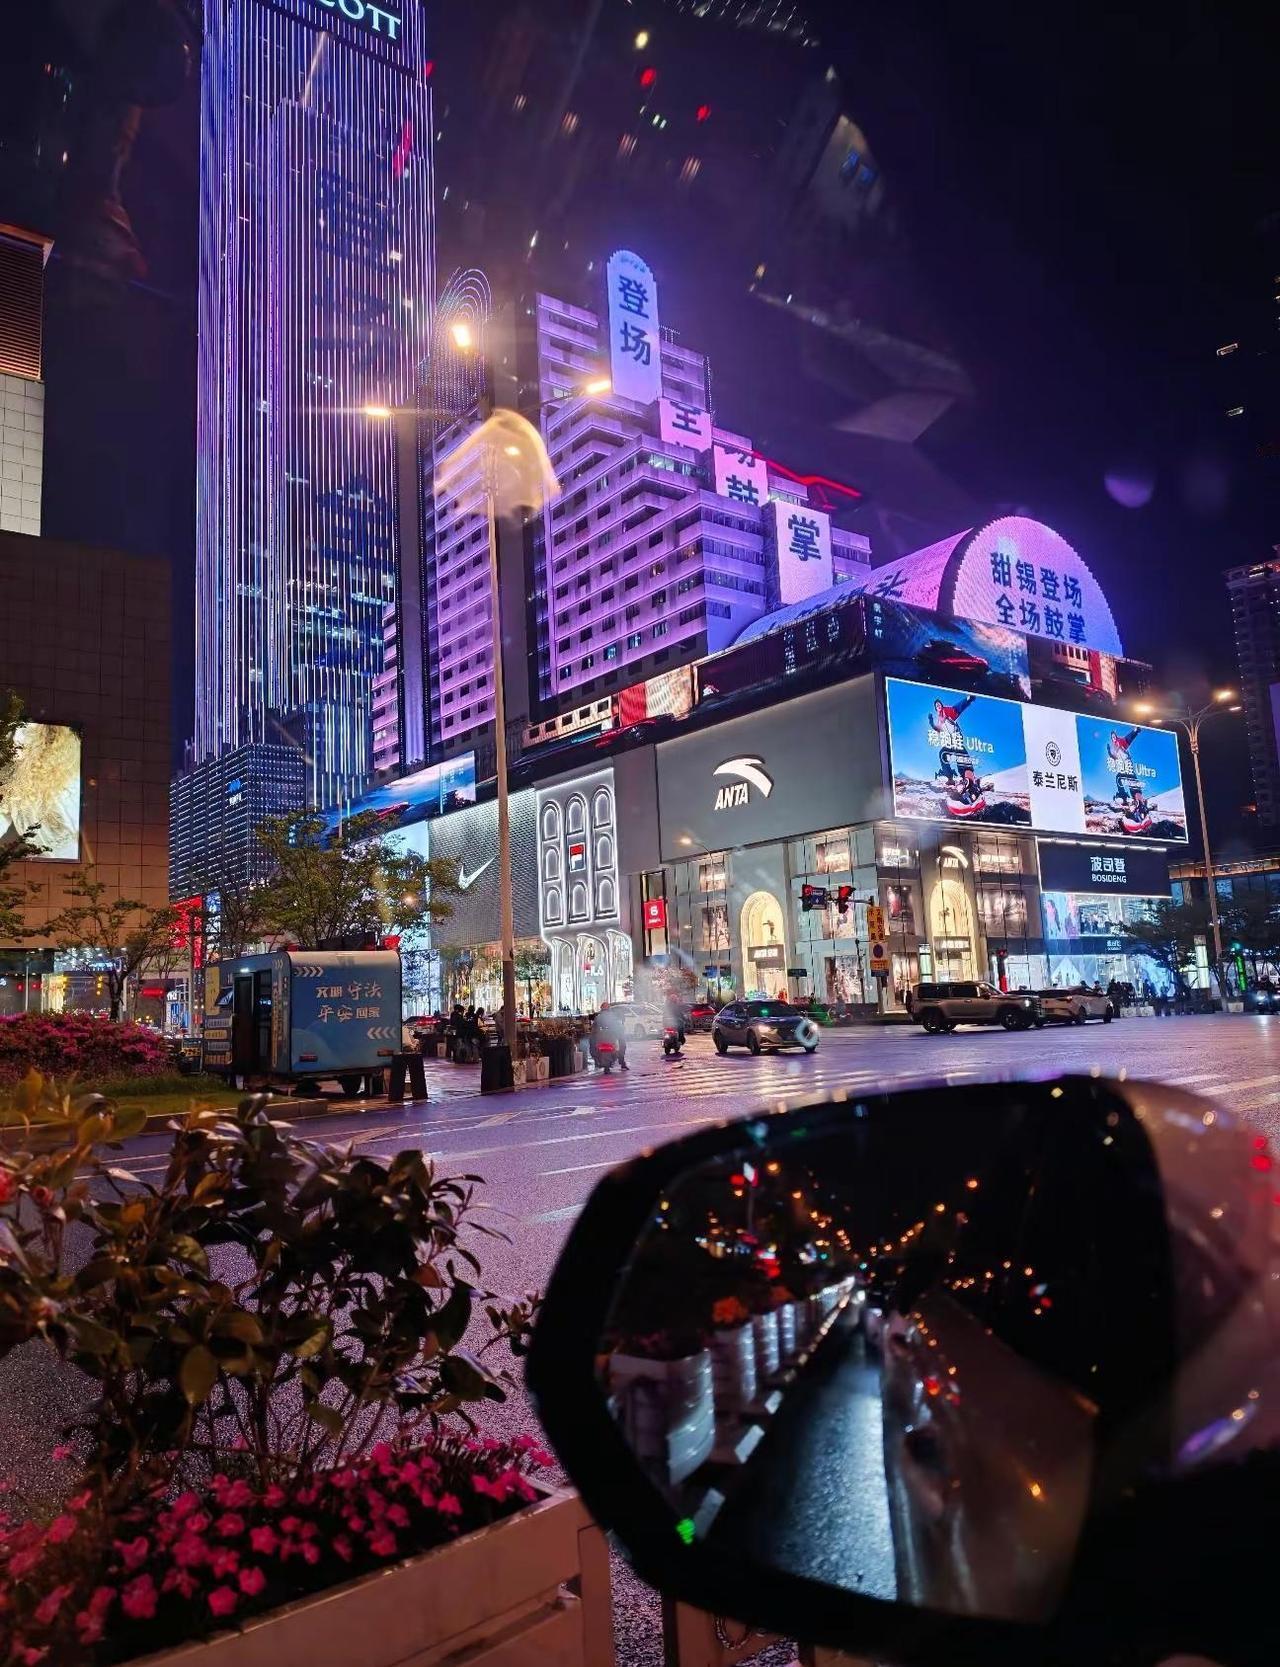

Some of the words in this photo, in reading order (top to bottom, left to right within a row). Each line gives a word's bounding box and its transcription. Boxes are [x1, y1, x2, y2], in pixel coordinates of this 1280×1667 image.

[618, 274, 651, 366] 登场
[787, 513, 822, 562] 掌
[990, 552, 1082, 609] 甜锡登场
[995, 593, 1087, 644] 全场鼓掌
[966, 736, 994, 753] Ultra
[1032, 770, 1079, 793] 泰兰尼斯
[1136, 763, 1157, 778] Ultra
[714, 782, 749, 811] ANTA
[1090, 856, 1126, 873] 波司登
[1091, 873, 1127, 883] BOSIDENG
